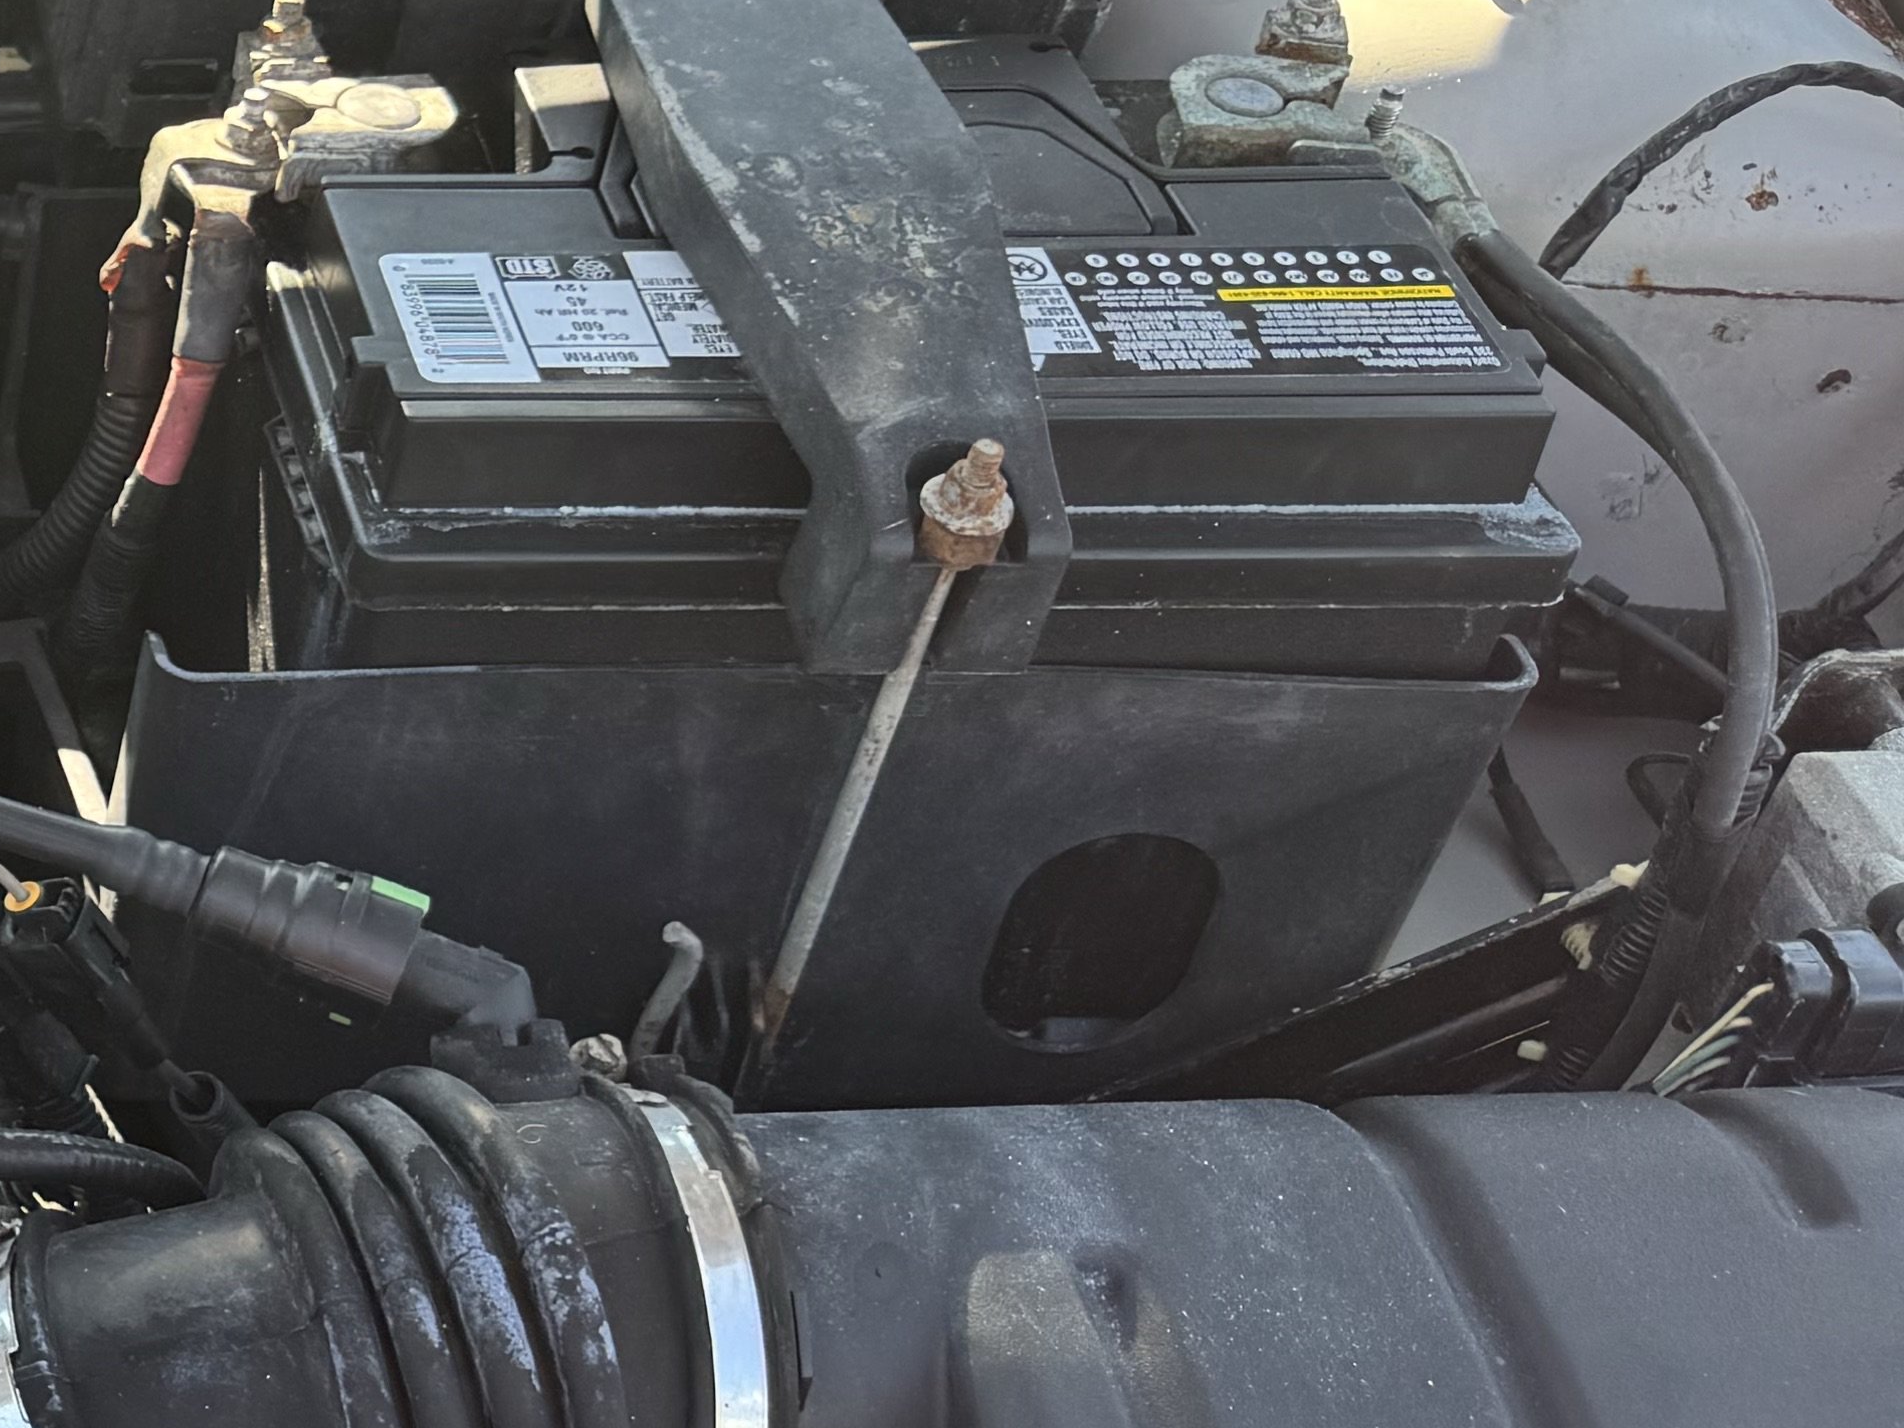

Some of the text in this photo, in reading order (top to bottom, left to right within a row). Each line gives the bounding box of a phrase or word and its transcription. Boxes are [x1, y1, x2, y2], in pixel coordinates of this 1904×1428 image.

[505, 259, 551, 274] STD
[554, 283, 589, 292] 12V
[1326, 289, 1379, 297] WARRANTY
[400, 282, 420, 316] 83996
[566, 297, 587, 306] 45
[656, 312, 676, 322] GET
[572, 322, 604, 332] 600
[601, 333, 630, 341] CCA
[563, 350, 639, 362] 96RPRM
